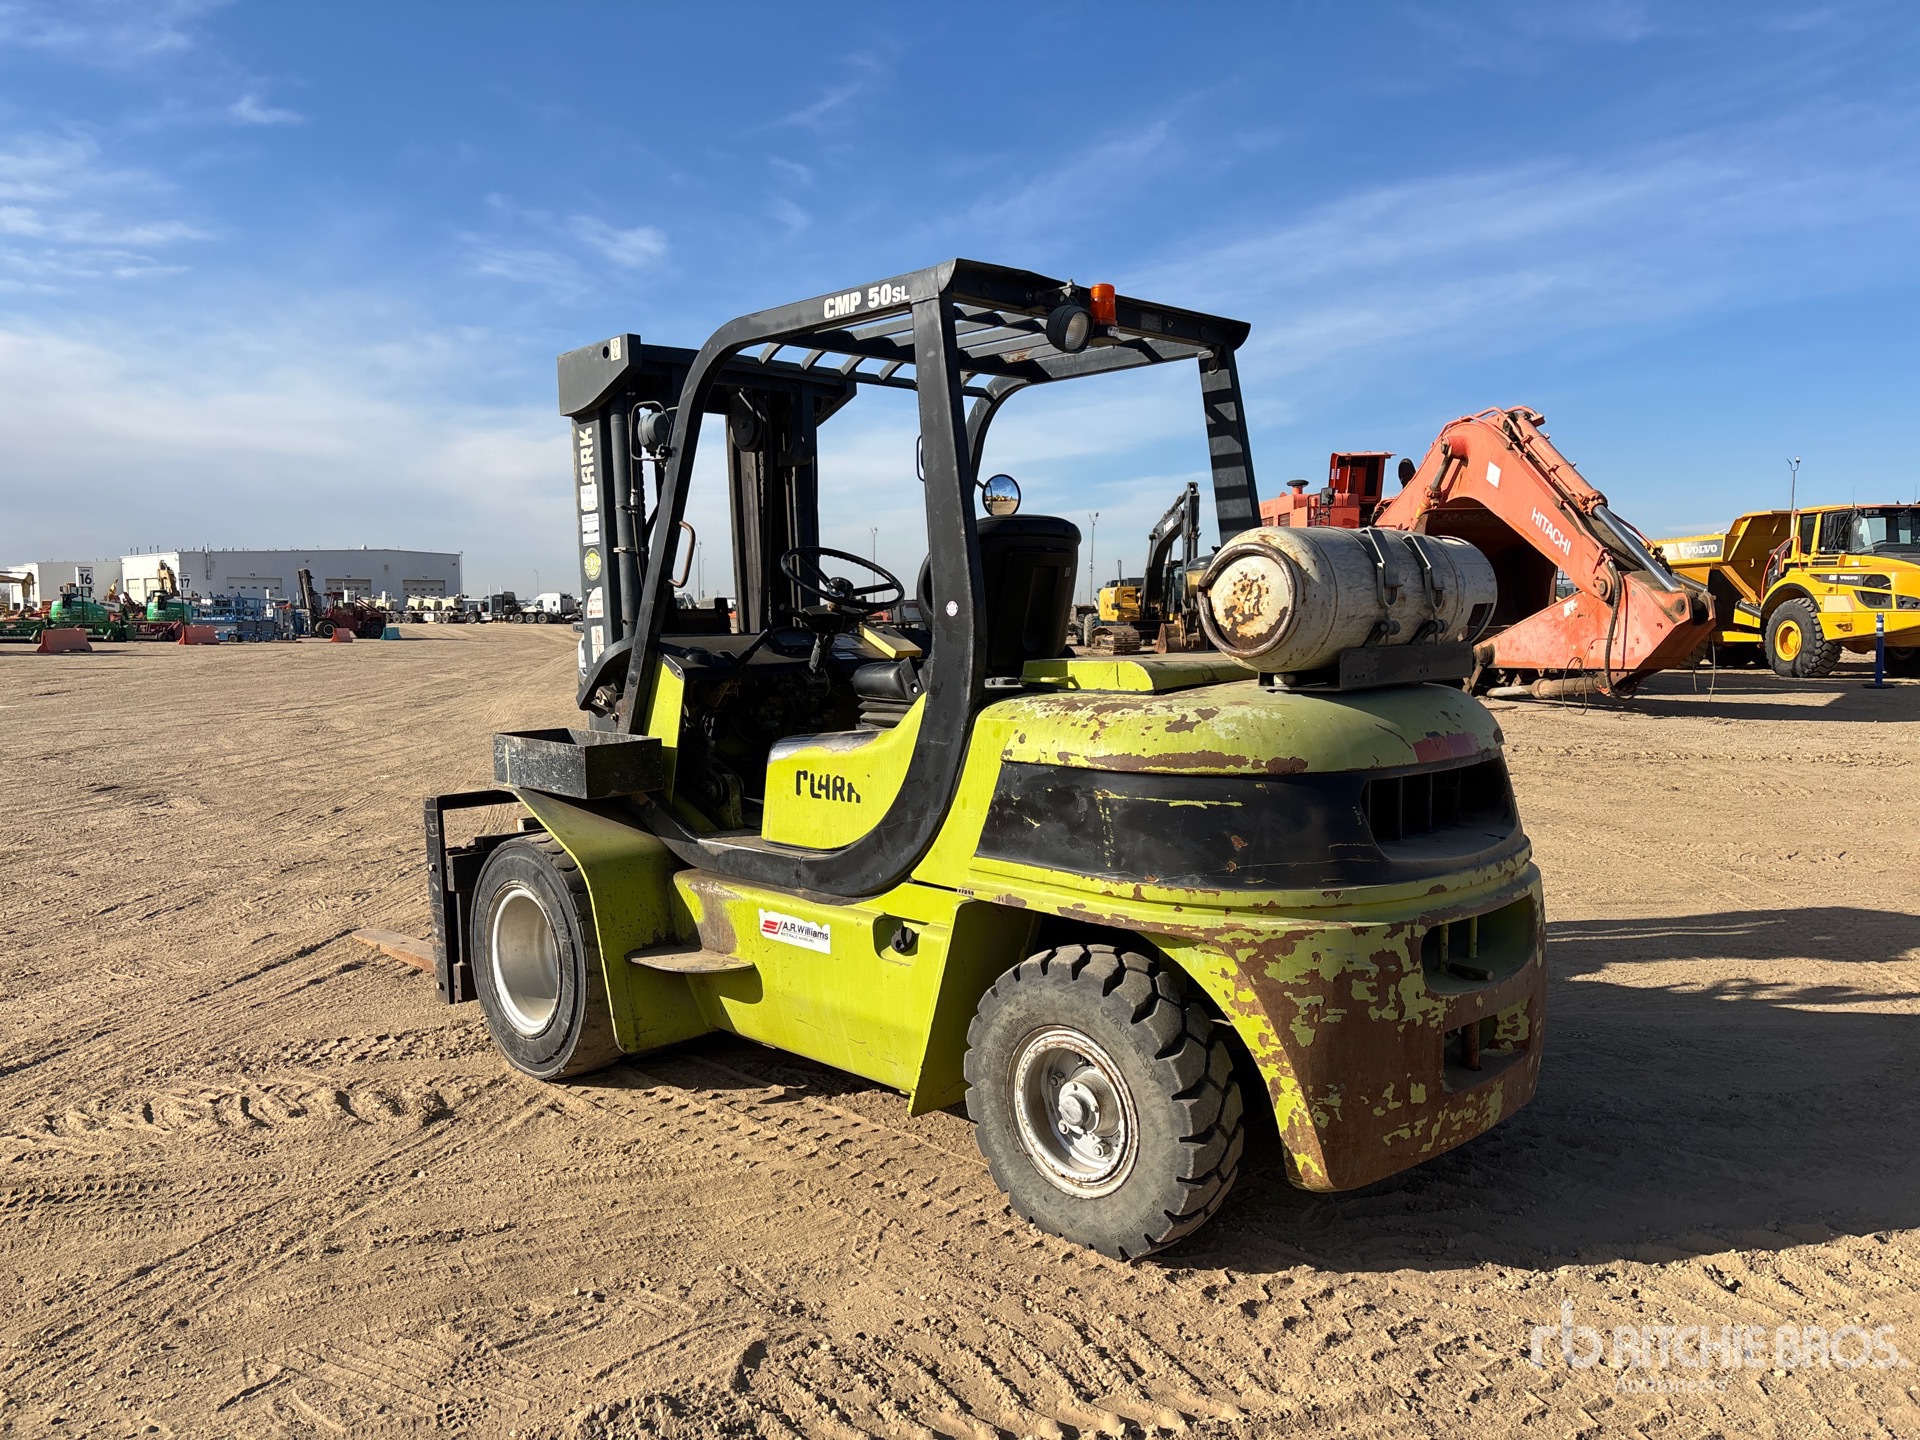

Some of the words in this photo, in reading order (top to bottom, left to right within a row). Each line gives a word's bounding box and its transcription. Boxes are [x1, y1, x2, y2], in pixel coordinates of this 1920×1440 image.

[823, 291, 862, 319] CMP
[1531, 506, 1572, 556] HITACHI
[1686, 544, 1718, 555] VOLVO
[79, 573, 92, 585] 16
[179, 577, 191, 588] 17
